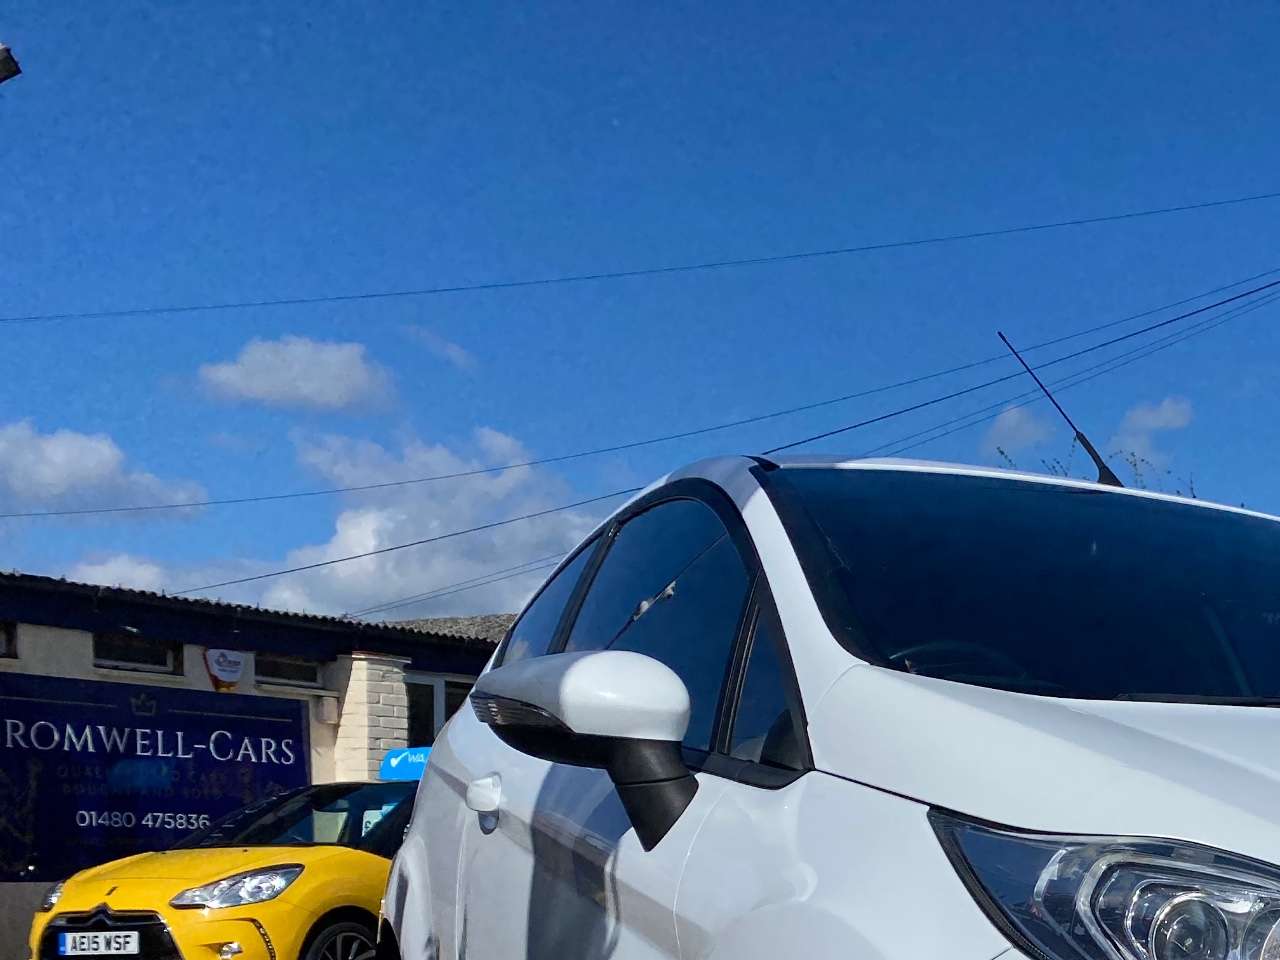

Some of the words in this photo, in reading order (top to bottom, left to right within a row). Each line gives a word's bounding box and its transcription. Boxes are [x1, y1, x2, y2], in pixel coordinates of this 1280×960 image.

[4, 719, 295, 765] ROMWELL-CARS
[76, 810, 136, 828] 01480
[141, 812, 210, 830] 475836
[70, 935, 100, 952] AE15
[104, 934, 132, 951] WSF
